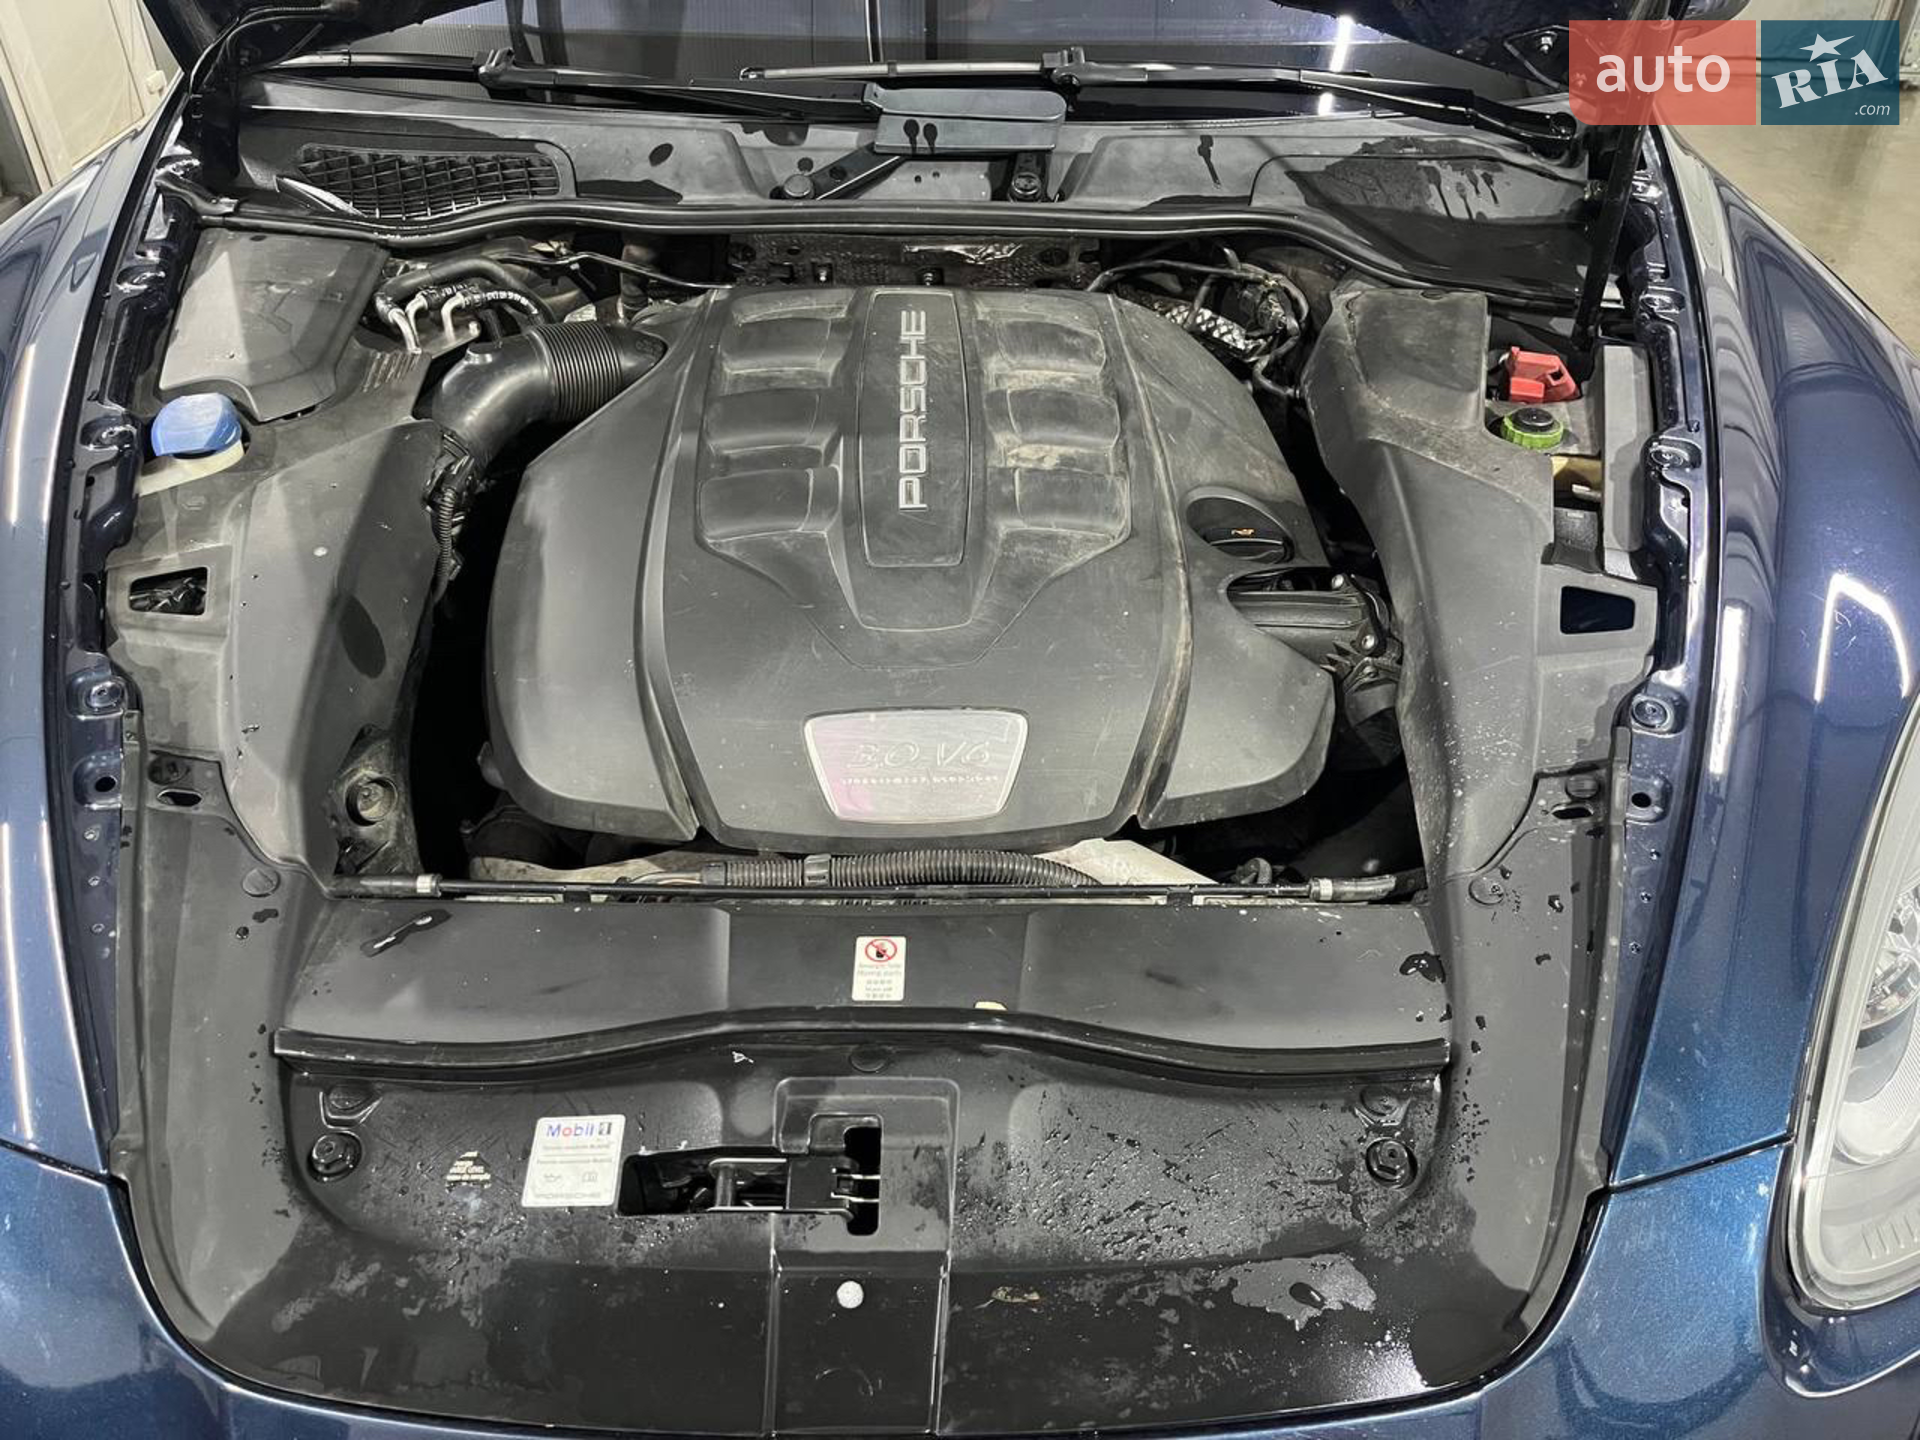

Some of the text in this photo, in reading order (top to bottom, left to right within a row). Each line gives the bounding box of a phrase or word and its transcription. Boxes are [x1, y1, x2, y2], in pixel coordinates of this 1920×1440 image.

[899, 310, 928, 511] PORSCHE
[936, 740, 991, 767] V6
[546, 1122, 595, 1137] Mobil
